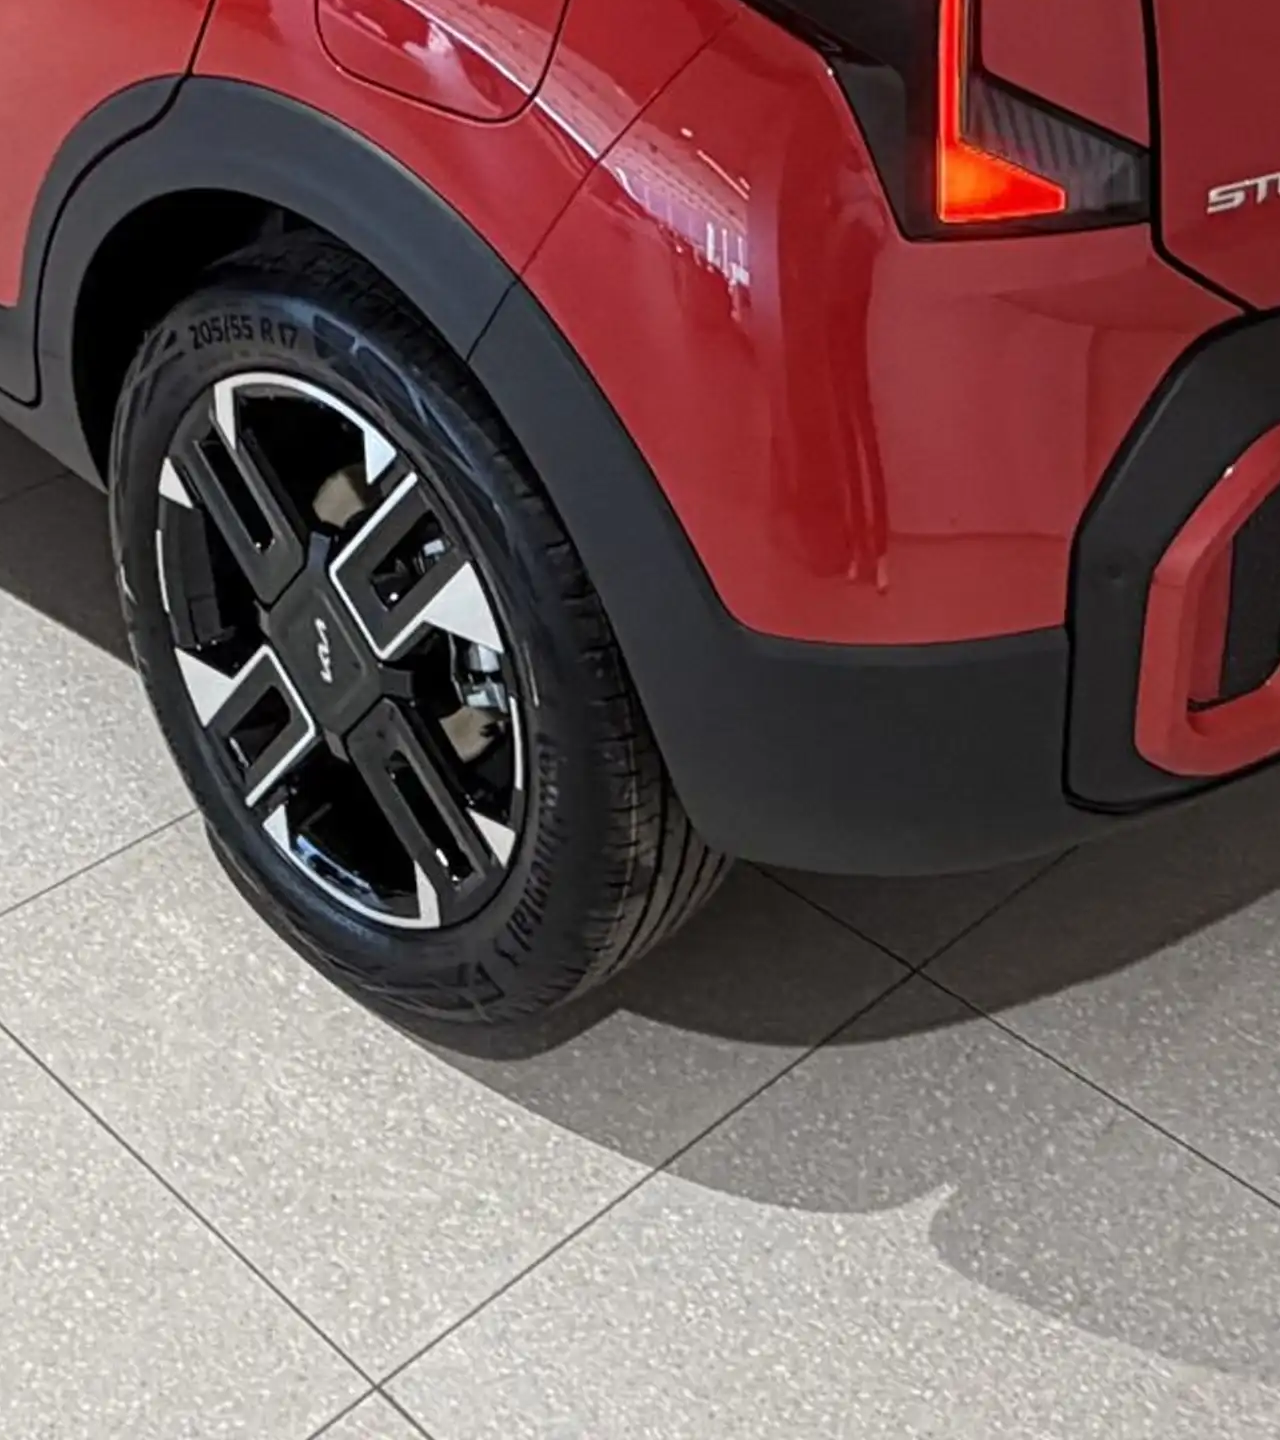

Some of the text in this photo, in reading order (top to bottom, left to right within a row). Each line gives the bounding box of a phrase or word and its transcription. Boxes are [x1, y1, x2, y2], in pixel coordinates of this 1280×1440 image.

[187, 313, 300, 351] 205/55 R 17
